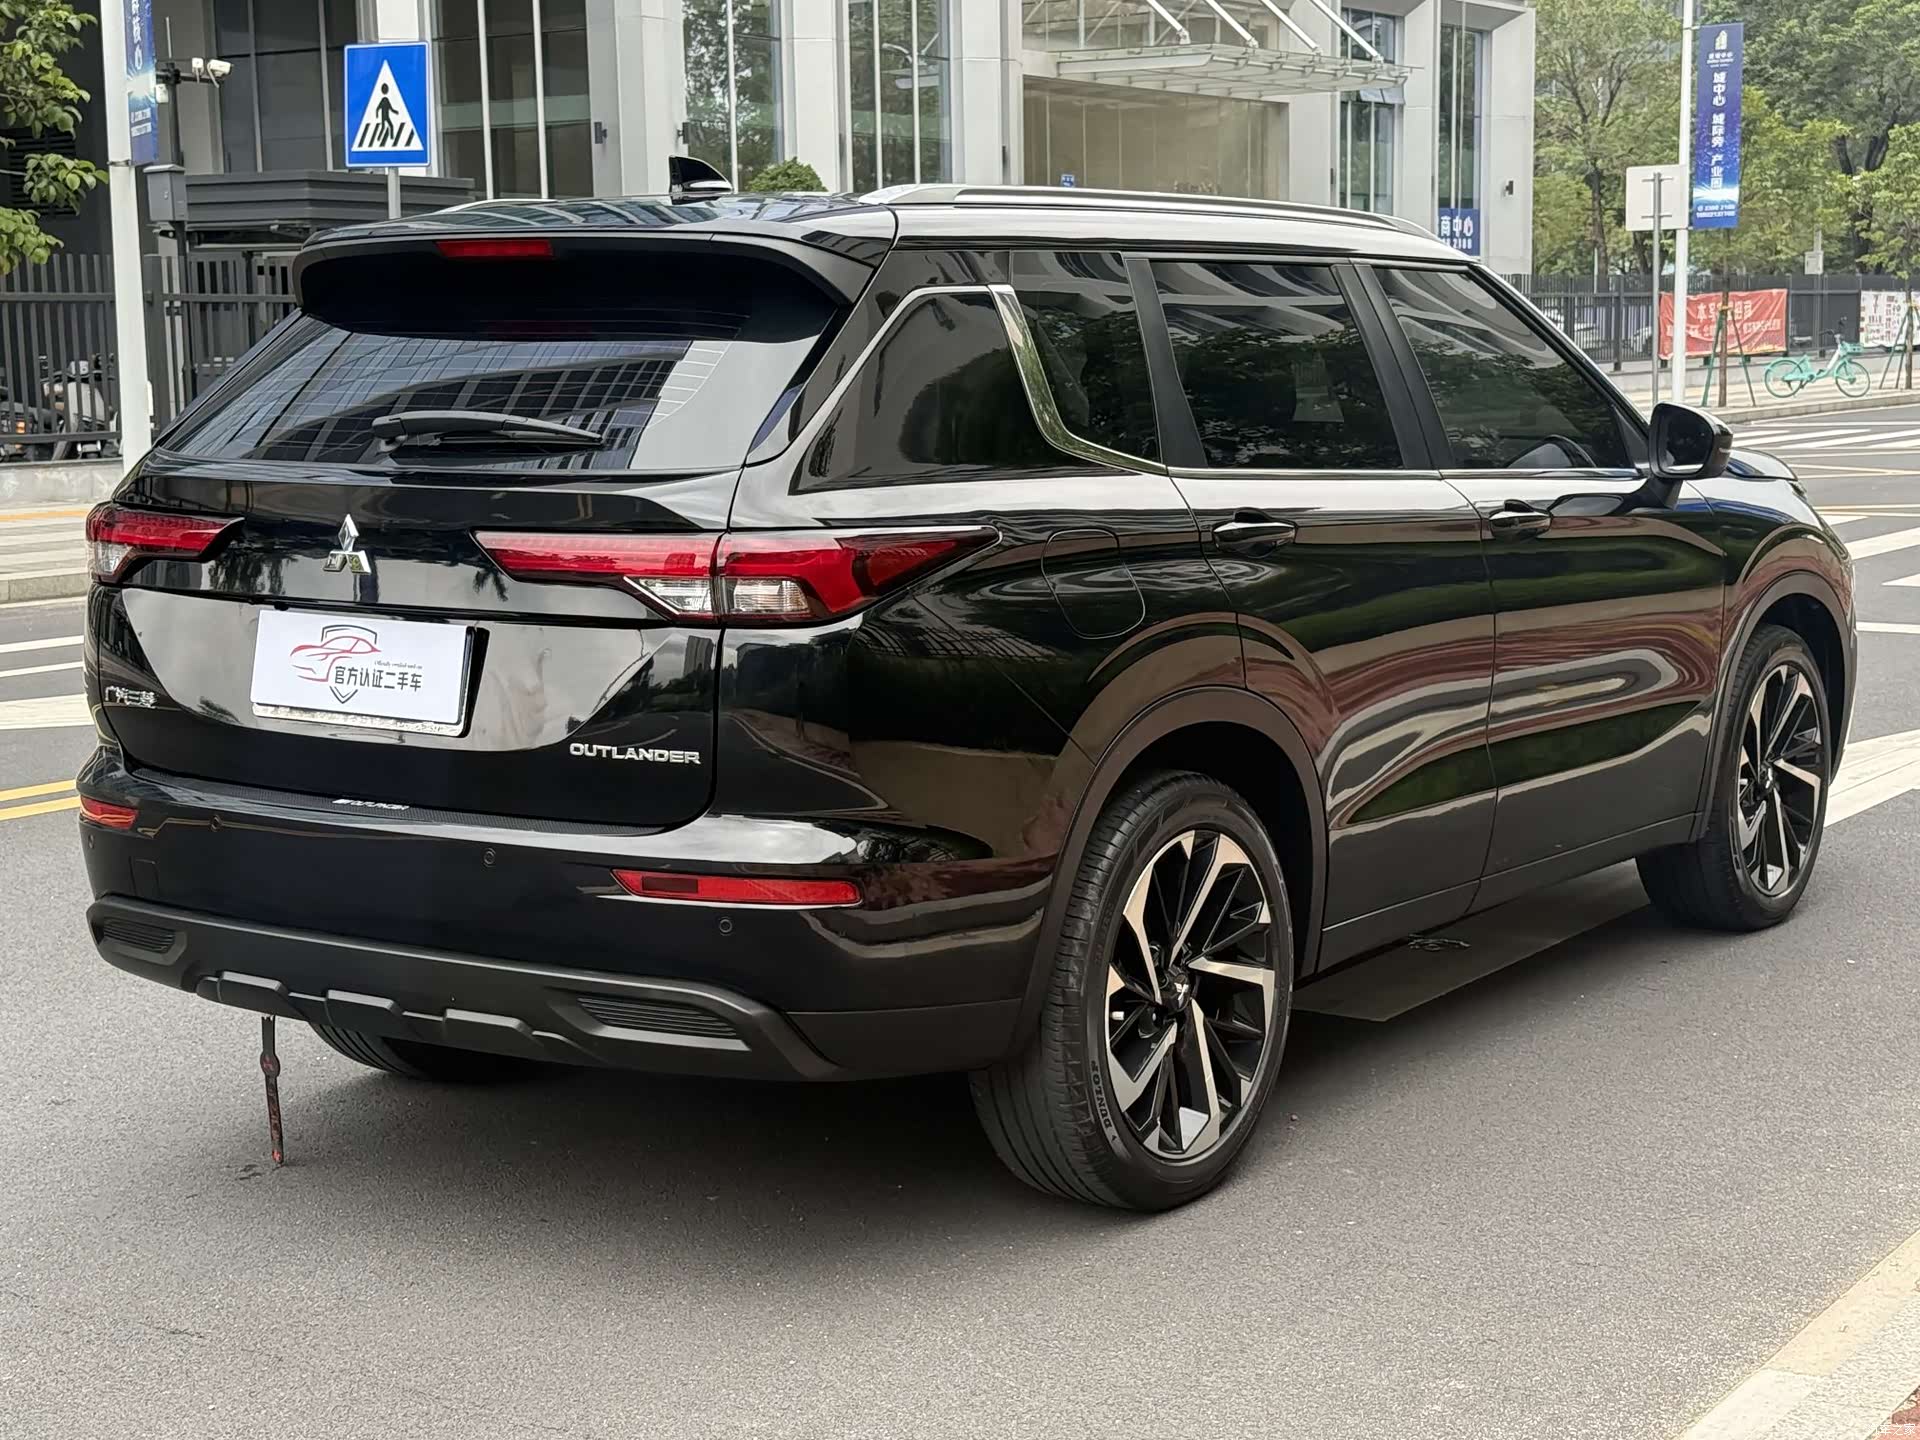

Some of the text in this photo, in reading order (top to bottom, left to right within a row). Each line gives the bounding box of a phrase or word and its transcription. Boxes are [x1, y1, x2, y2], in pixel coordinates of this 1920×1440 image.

[1712, 72, 1726, 106] 城中心
[1711, 154, 1724, 190] 产业园
[334, 666, 423, 692] 官方认证二手车
[569, 743, 701, 765] OUTLANDER
[1090, 1060, 1113, 1129] DUNLOP
